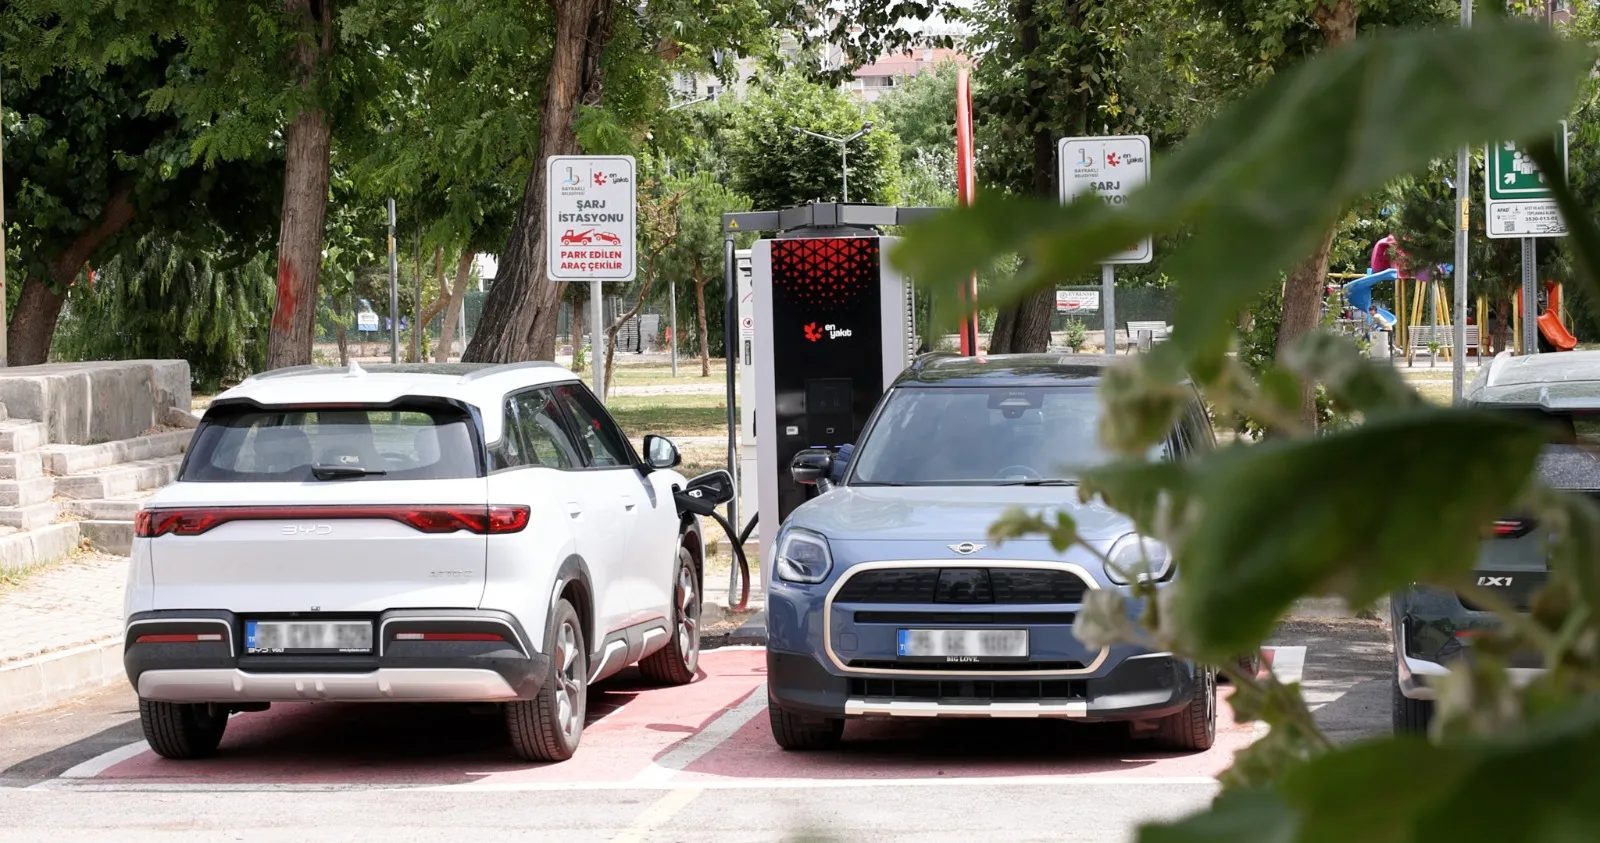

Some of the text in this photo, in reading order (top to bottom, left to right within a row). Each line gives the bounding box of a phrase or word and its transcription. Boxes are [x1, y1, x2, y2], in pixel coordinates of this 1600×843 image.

[576, 199, 606, 212] ŞARJ
[558, 210, 624, 222] İSTASYONU
[560, 249, 622, 259] PARK EDİLEN
[560, 260, 622, 271] ARAÇ ÇEKİLİR
[830, 328, 852, 339] yakıt
[281, 524, 332, 536] BYD
